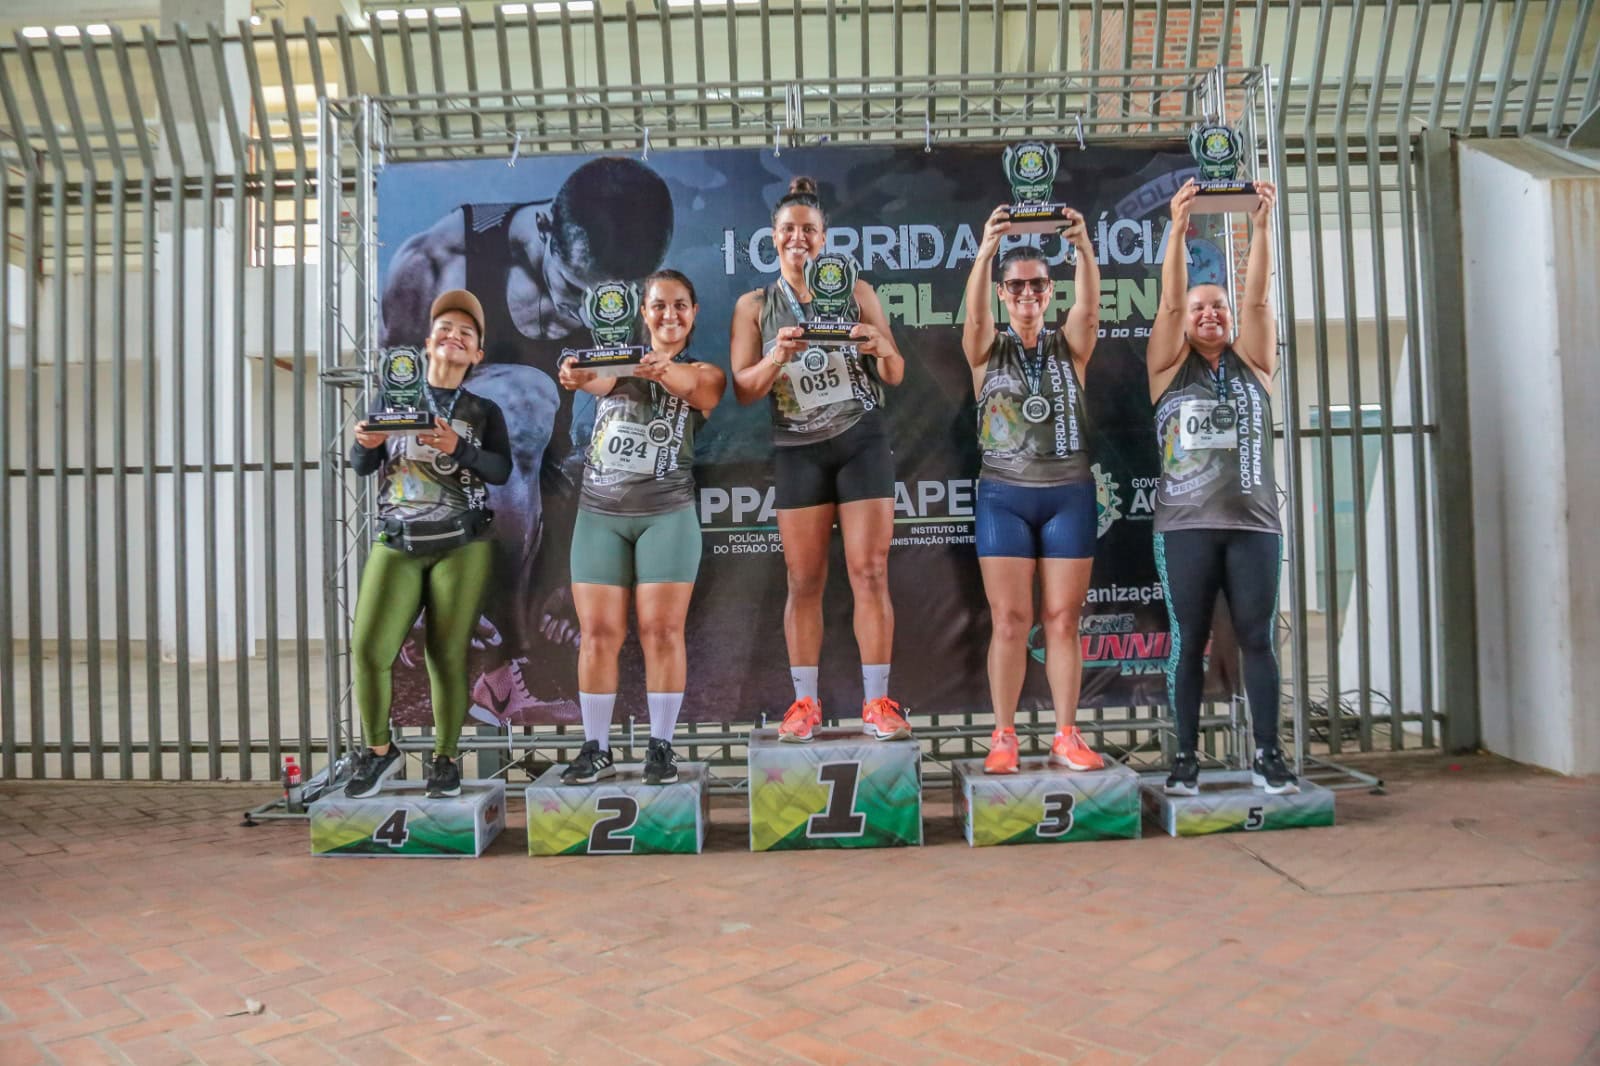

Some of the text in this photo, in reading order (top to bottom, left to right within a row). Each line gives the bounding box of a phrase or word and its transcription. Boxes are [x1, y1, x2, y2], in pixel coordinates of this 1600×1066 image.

[749, 225, 983, 273] CRRIDA
[1111, 328, 1130, 338] DO
[1134, 327, 1153, 337] SU
[800, 368, 840, 394] 035
[1054, 395, 1064, 412] DA
[1061, 361, 1079, 450] ENAL/IAPEN
[1230, 376, 1249, 415] POLÍCIA
[1186, 416, 1225, 434] 04
[1239, 417, 1250, 434] DA
[1246, 383, 1262, 486] PENAL/IAPEN
[608, 436, 649, 459] 024
[1240, 436, 1252, 488] CORRIDA
[1131, 477, 1160, 488] GOVE
[700, 486, 777, 524] PPA
[894, 479, 979, 517] APE
[728, 532, 765, 543] POLÍCIA
[890, 534, 976, 546] INISTRAÇÃO PENITE
[911, 525, 969, 534] INSTITUTO DE
[713, 545, 728, 554] DO
[731, 543, 768, 554] ESTADO
[1082, 582, 1164, 607] anizaçã
[1079, 613, 1135, 634] CRE
[1080, 632, 1171, 660] UNNI
[1120, 660, 1168, 676] EVEN
[806, 761, 866, 839] 1
[587, 795, 640, 853] 2
[1036, 793, 1074, 837] 3
[1244, 806, 1264, 831] 5
[372, 808, 410, 848] 4
